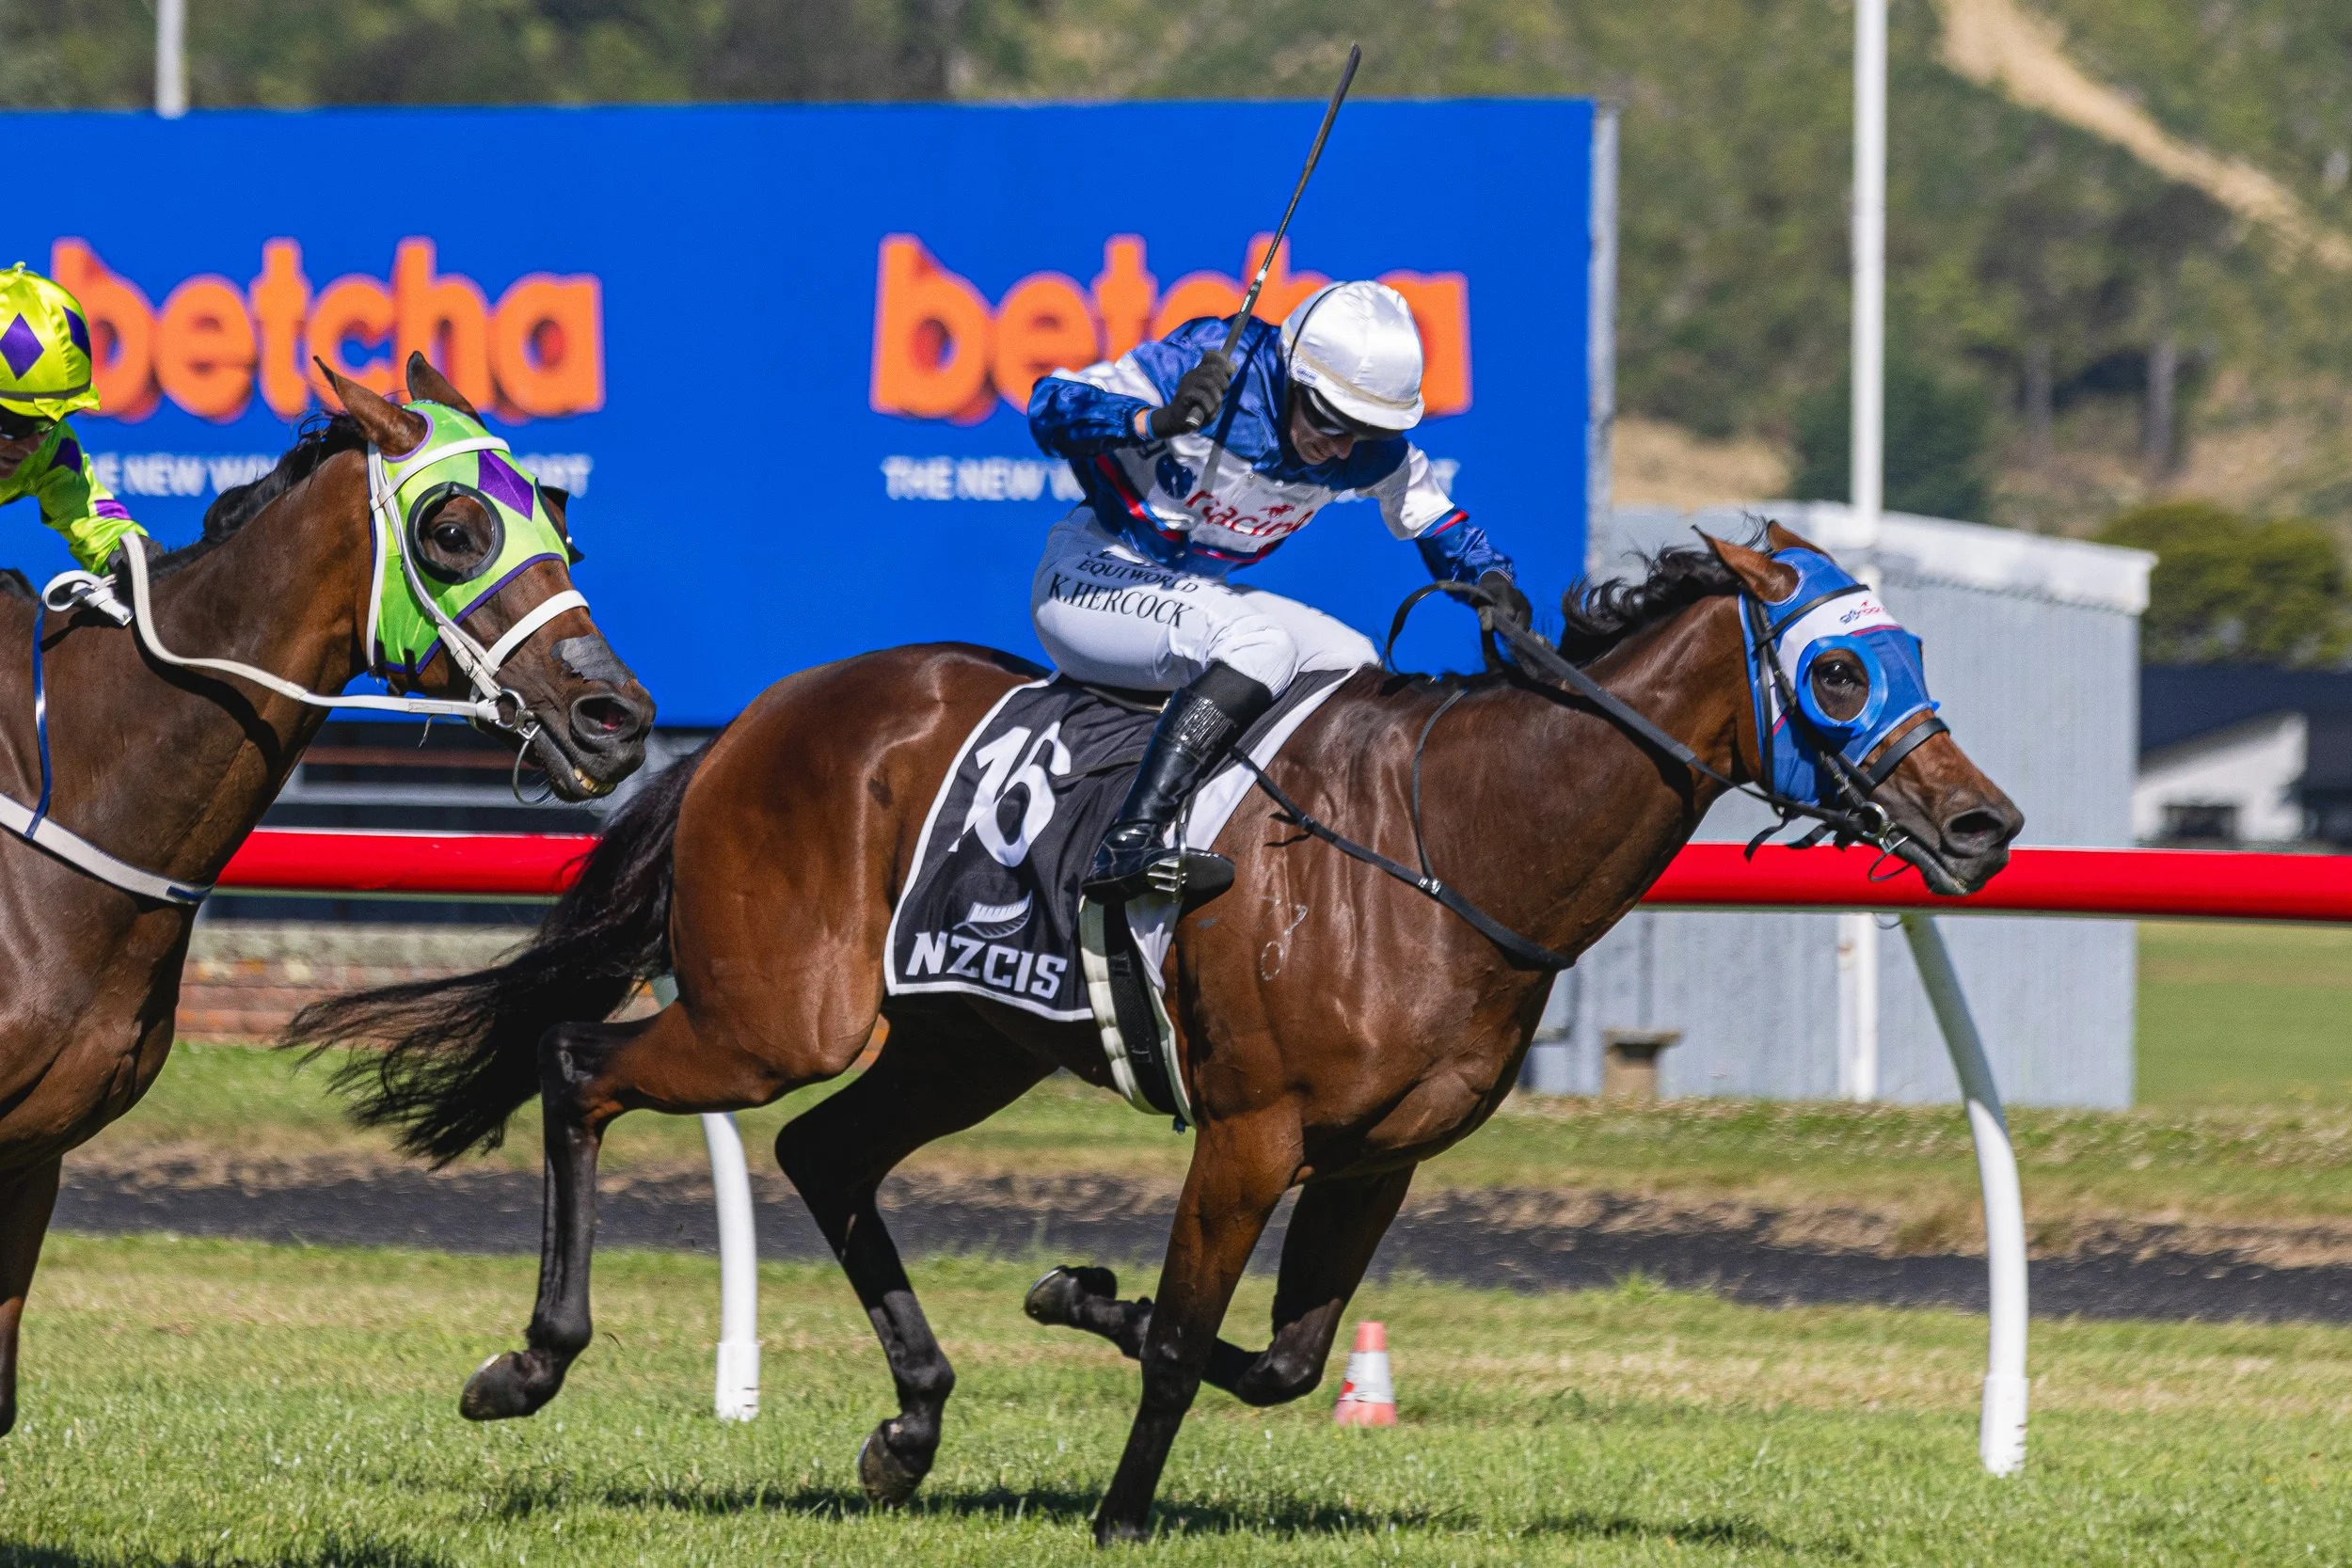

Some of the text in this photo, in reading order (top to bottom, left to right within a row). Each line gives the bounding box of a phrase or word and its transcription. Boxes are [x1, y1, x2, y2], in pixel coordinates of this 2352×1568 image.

[51, 237, 603, 423] betcha
[122, 453, 207, 497] NEW
[208, 454, 279, 496] WA
[880, 456, 955, 500] THE
[956, 457, 1046, 501] NEW
[1047, 573, 1194, 628] K.HERCOCK
[947, 721, 1072, 867] 16
[905, 931, 1068, 999] NZCIS
